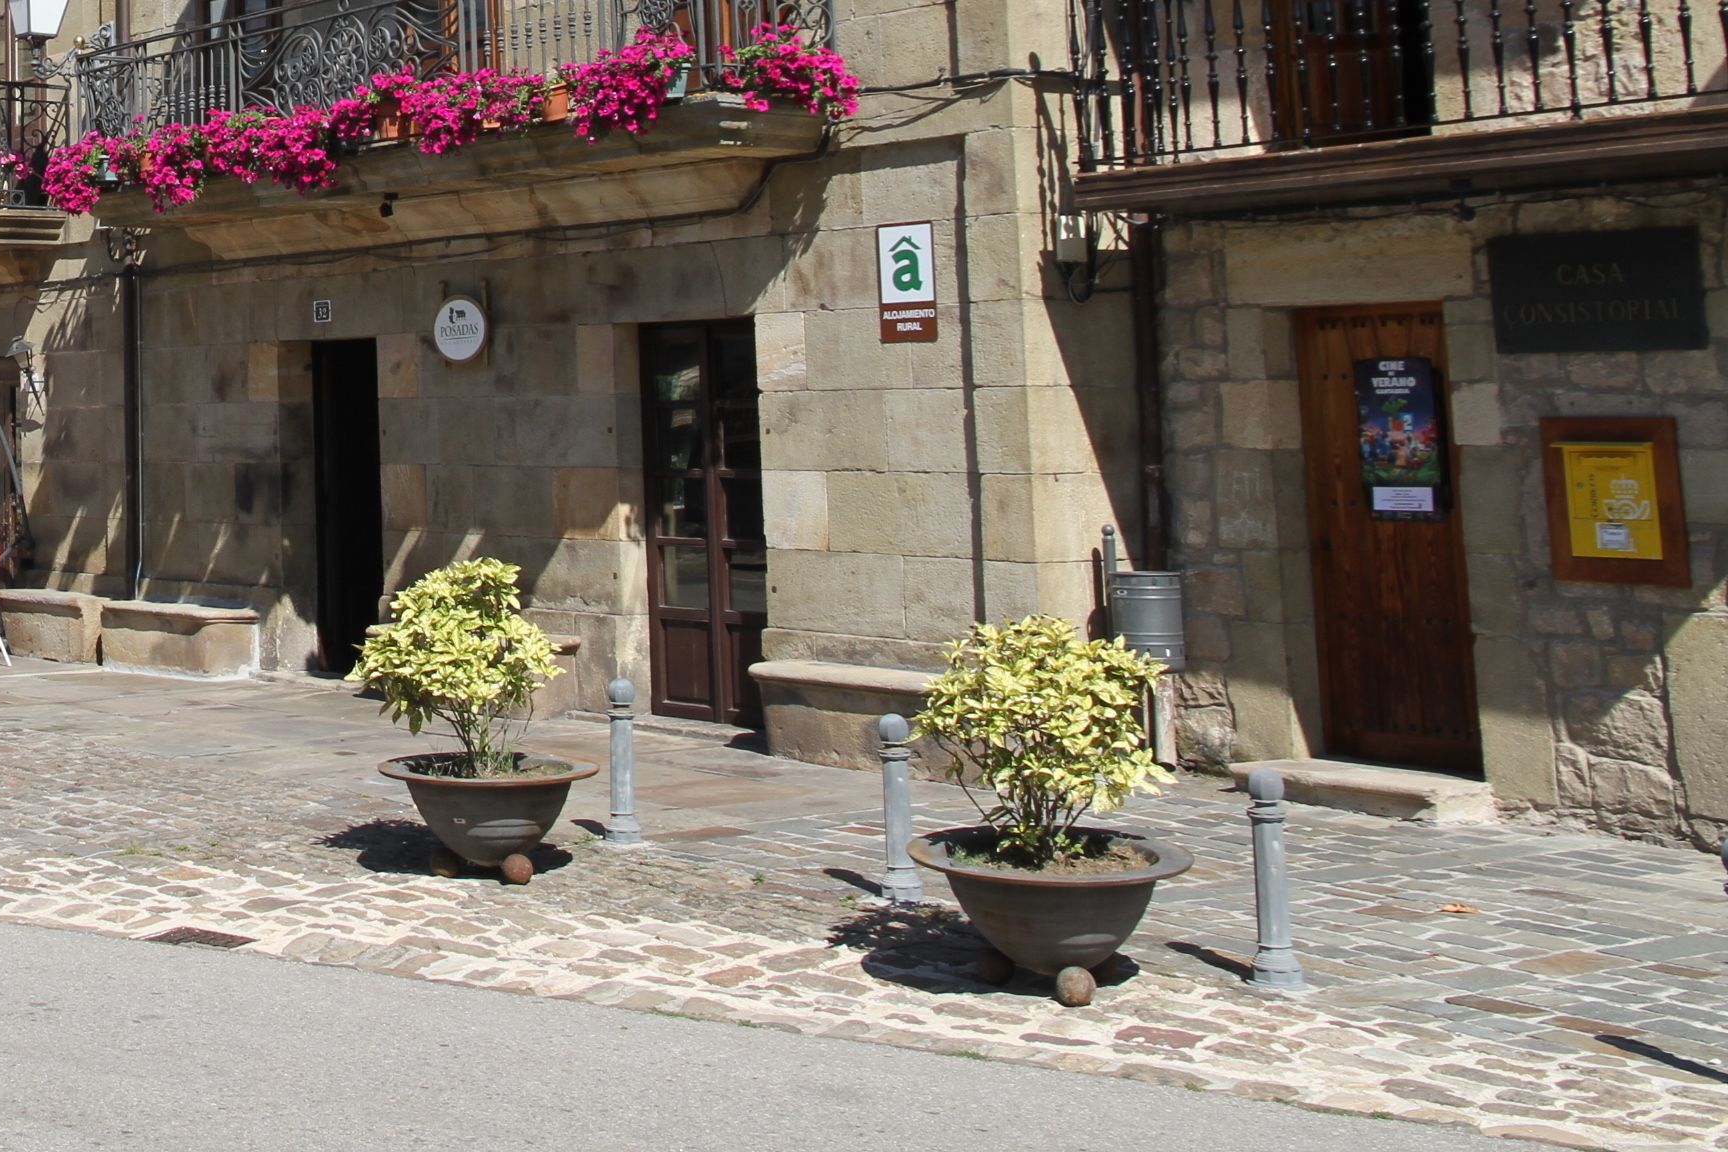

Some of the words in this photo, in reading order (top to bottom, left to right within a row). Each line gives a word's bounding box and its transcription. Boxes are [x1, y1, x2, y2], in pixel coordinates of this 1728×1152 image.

[1556, 262, 1625, 287] CASA
[883, 309, 936, 320] ALOJAMIENTO
[440, 323, 479, 337] POSADAS
[896, 322, 923, 332] RURAL
[1378, 360, 1405, 371] CINE
[1371, 377, 1416, 387] VERANO
